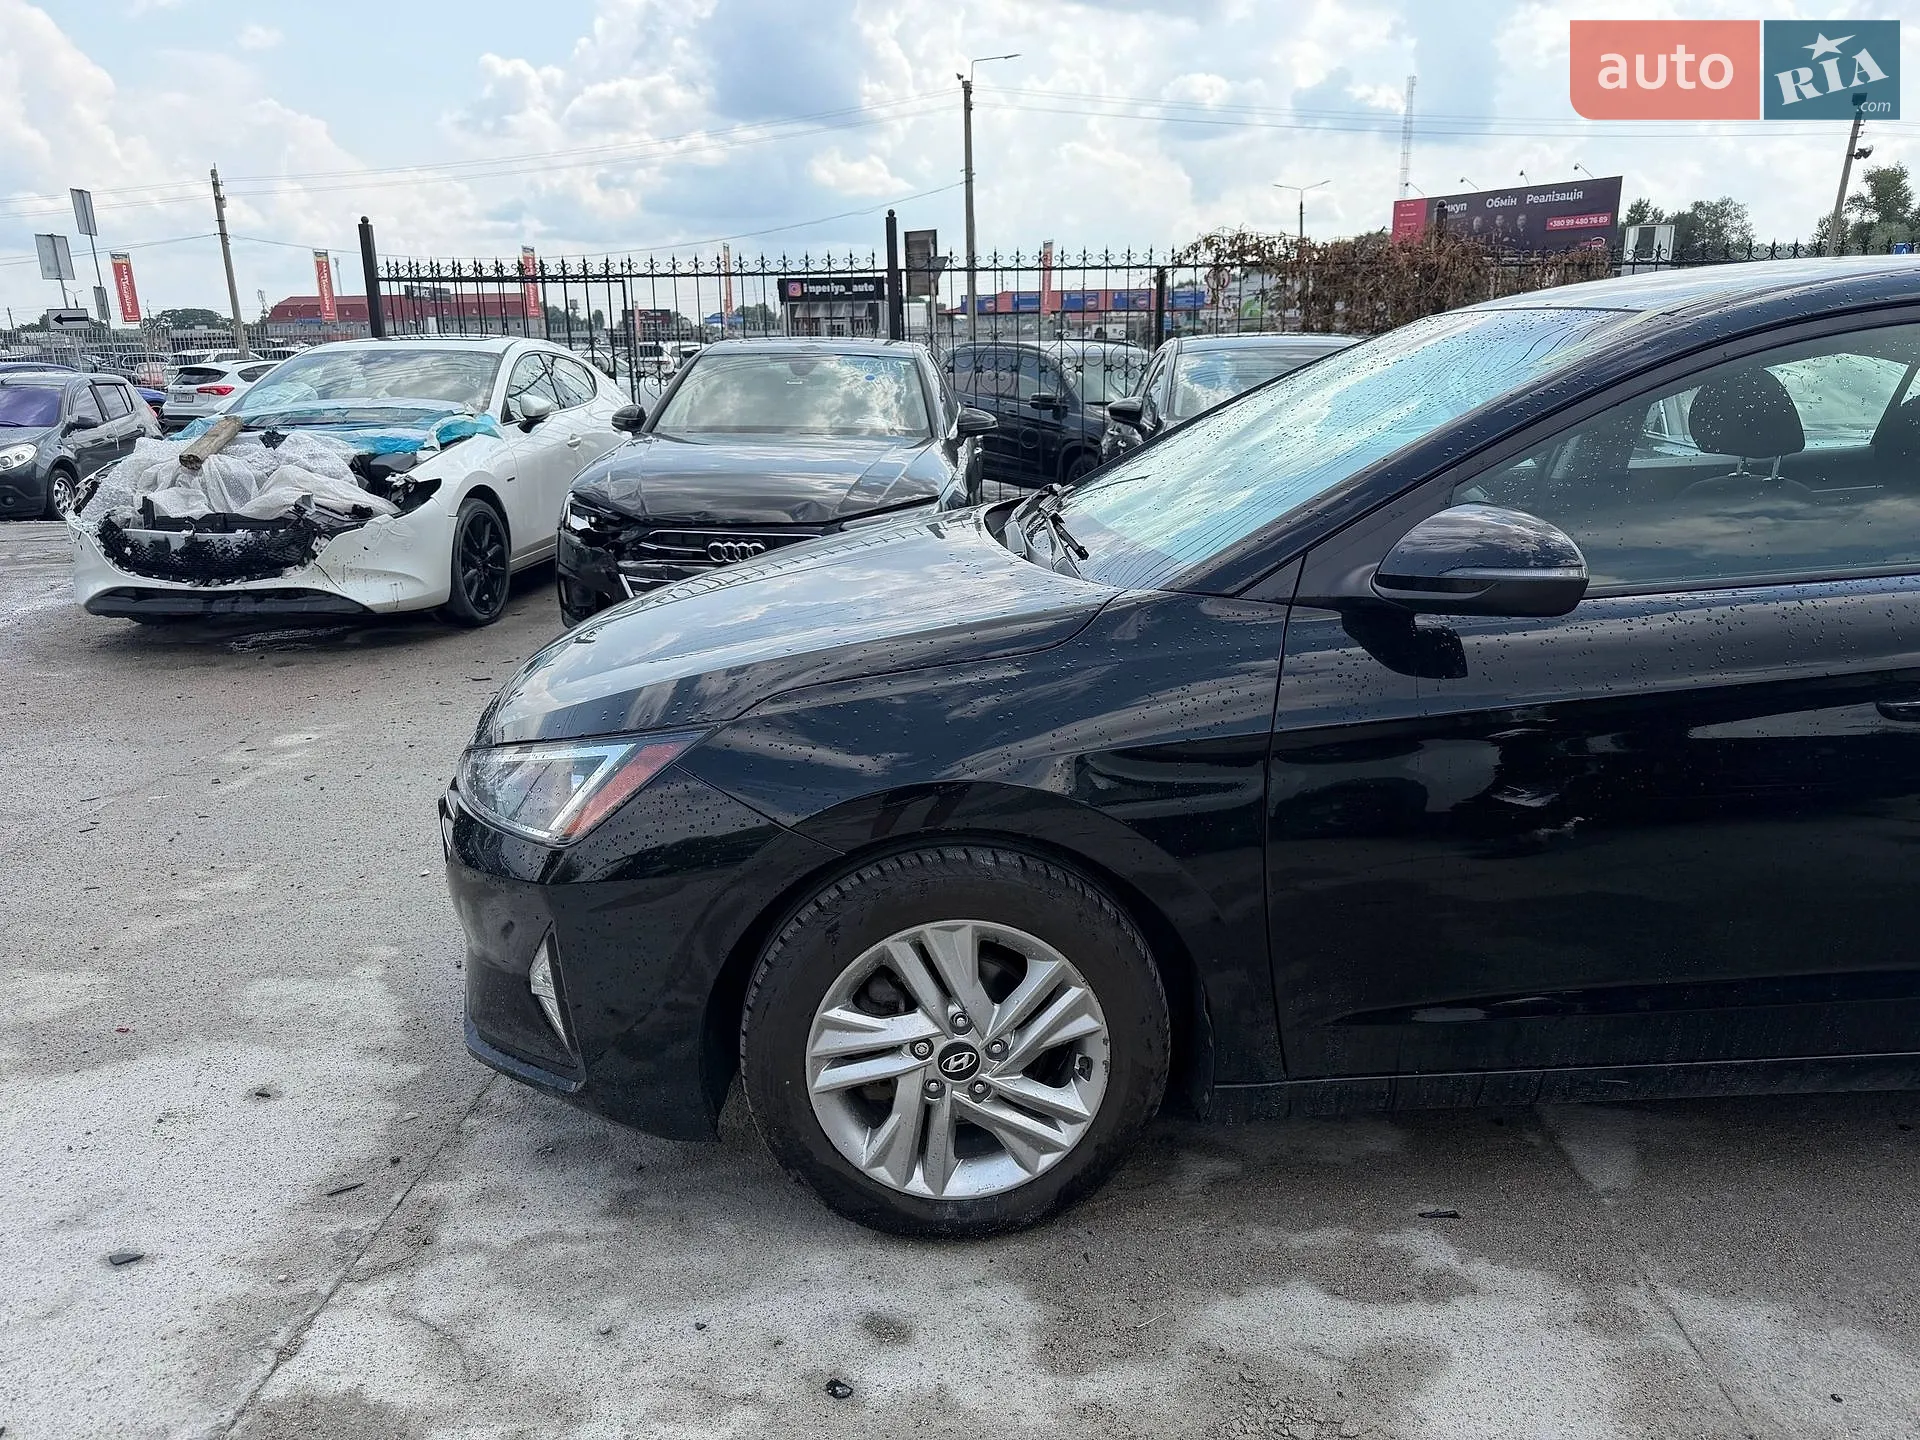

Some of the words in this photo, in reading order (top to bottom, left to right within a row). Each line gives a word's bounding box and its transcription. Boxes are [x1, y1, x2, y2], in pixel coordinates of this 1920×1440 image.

[1443, 202, 1467, 214] икуп
[1486, 195, 1517, 209] Обмін
[1526, 188, 1583, 204] Реалізація
